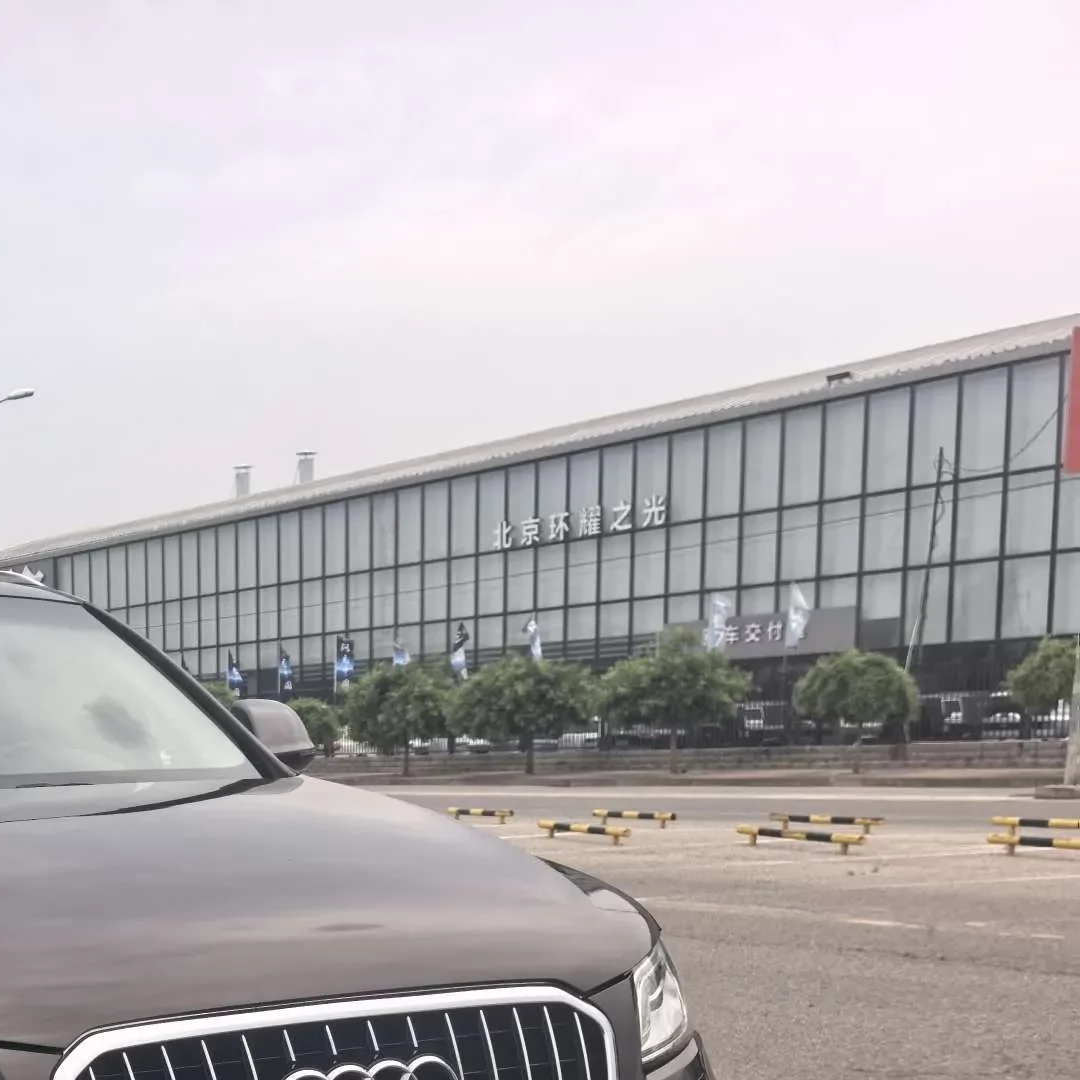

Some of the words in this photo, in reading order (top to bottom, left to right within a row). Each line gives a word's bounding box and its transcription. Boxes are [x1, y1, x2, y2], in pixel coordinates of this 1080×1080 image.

[492, 494, 667, 550] 北京环耀之光
[702, 619, 806, 647] 车交付
